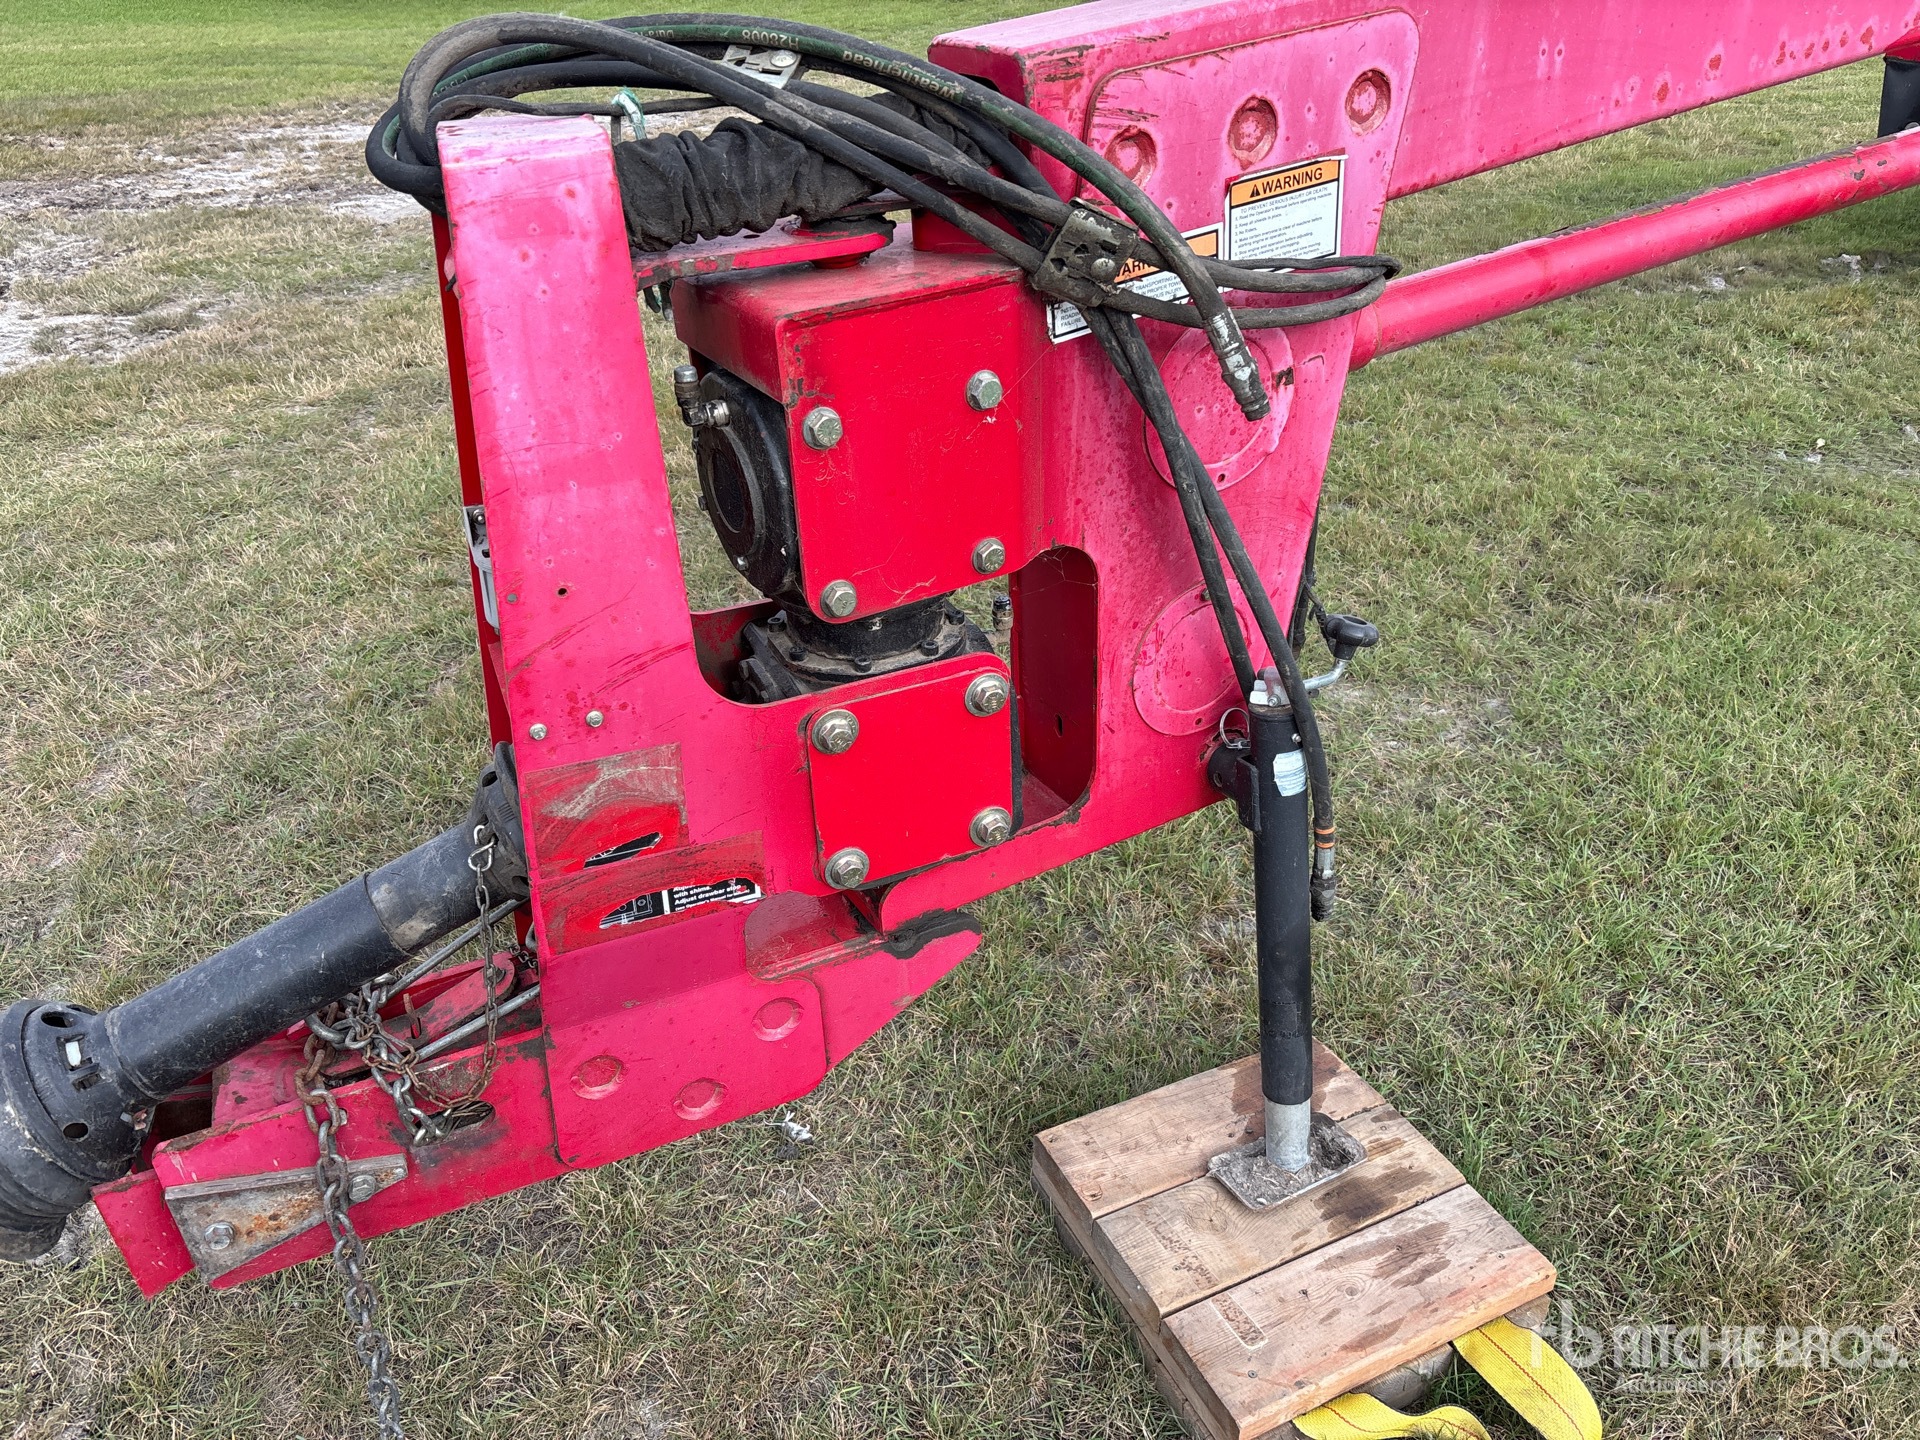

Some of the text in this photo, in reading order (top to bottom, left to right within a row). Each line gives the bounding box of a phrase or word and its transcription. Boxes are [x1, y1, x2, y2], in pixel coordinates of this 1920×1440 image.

[742, 28, 799, 48] H28008
[842, 50, 957, 100] Weatherhead
[1262, 167, 1322, 194] WARNING
[1248, 202, 1267, 211] PREVENT
[1269, 197, 1288, 205] SERIOUS
[1136, 276, 1173, 290] TRANSPORTING
[674, 895, 697, 905] Adjust
[698, 888, 726, 900] drawbar
[690, 886, 712, 894] shims.
